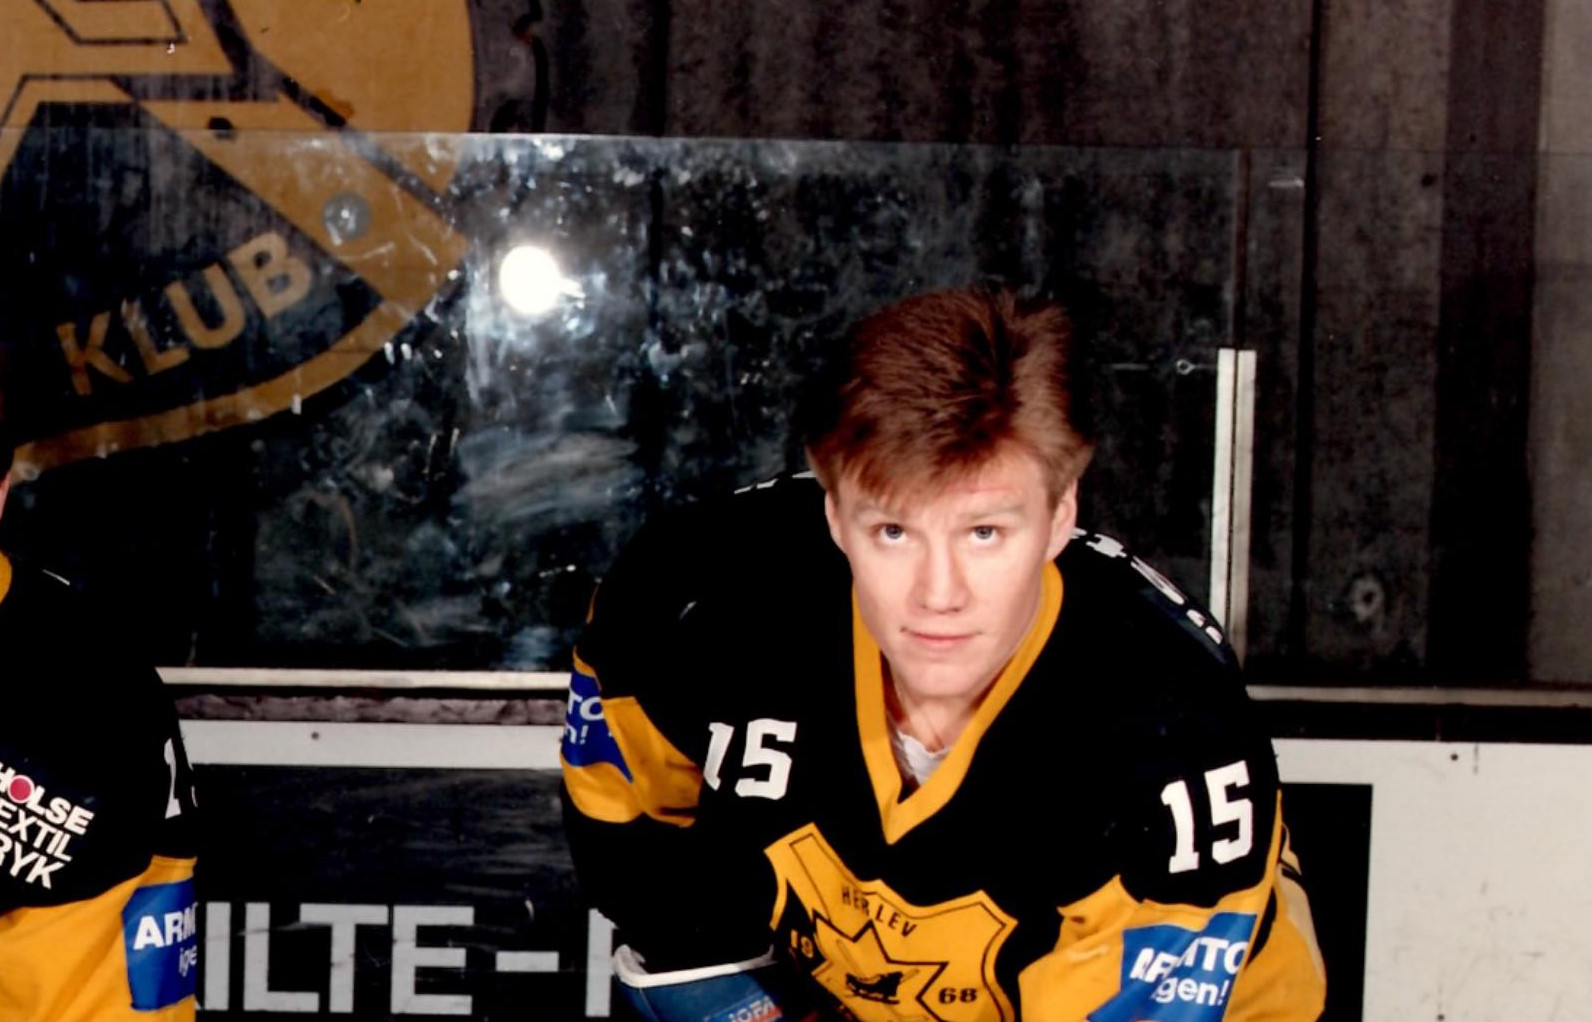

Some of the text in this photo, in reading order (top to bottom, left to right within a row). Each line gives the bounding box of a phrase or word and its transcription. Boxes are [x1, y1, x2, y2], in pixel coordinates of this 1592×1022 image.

[55, 231, 314, 397] KLUB
[703, 718, 798, 801] 15
[1161, 760, 1253, 873] 15
[841, 886, 918, 938] HERLEV
[938, 988, 978, 1005] 68
